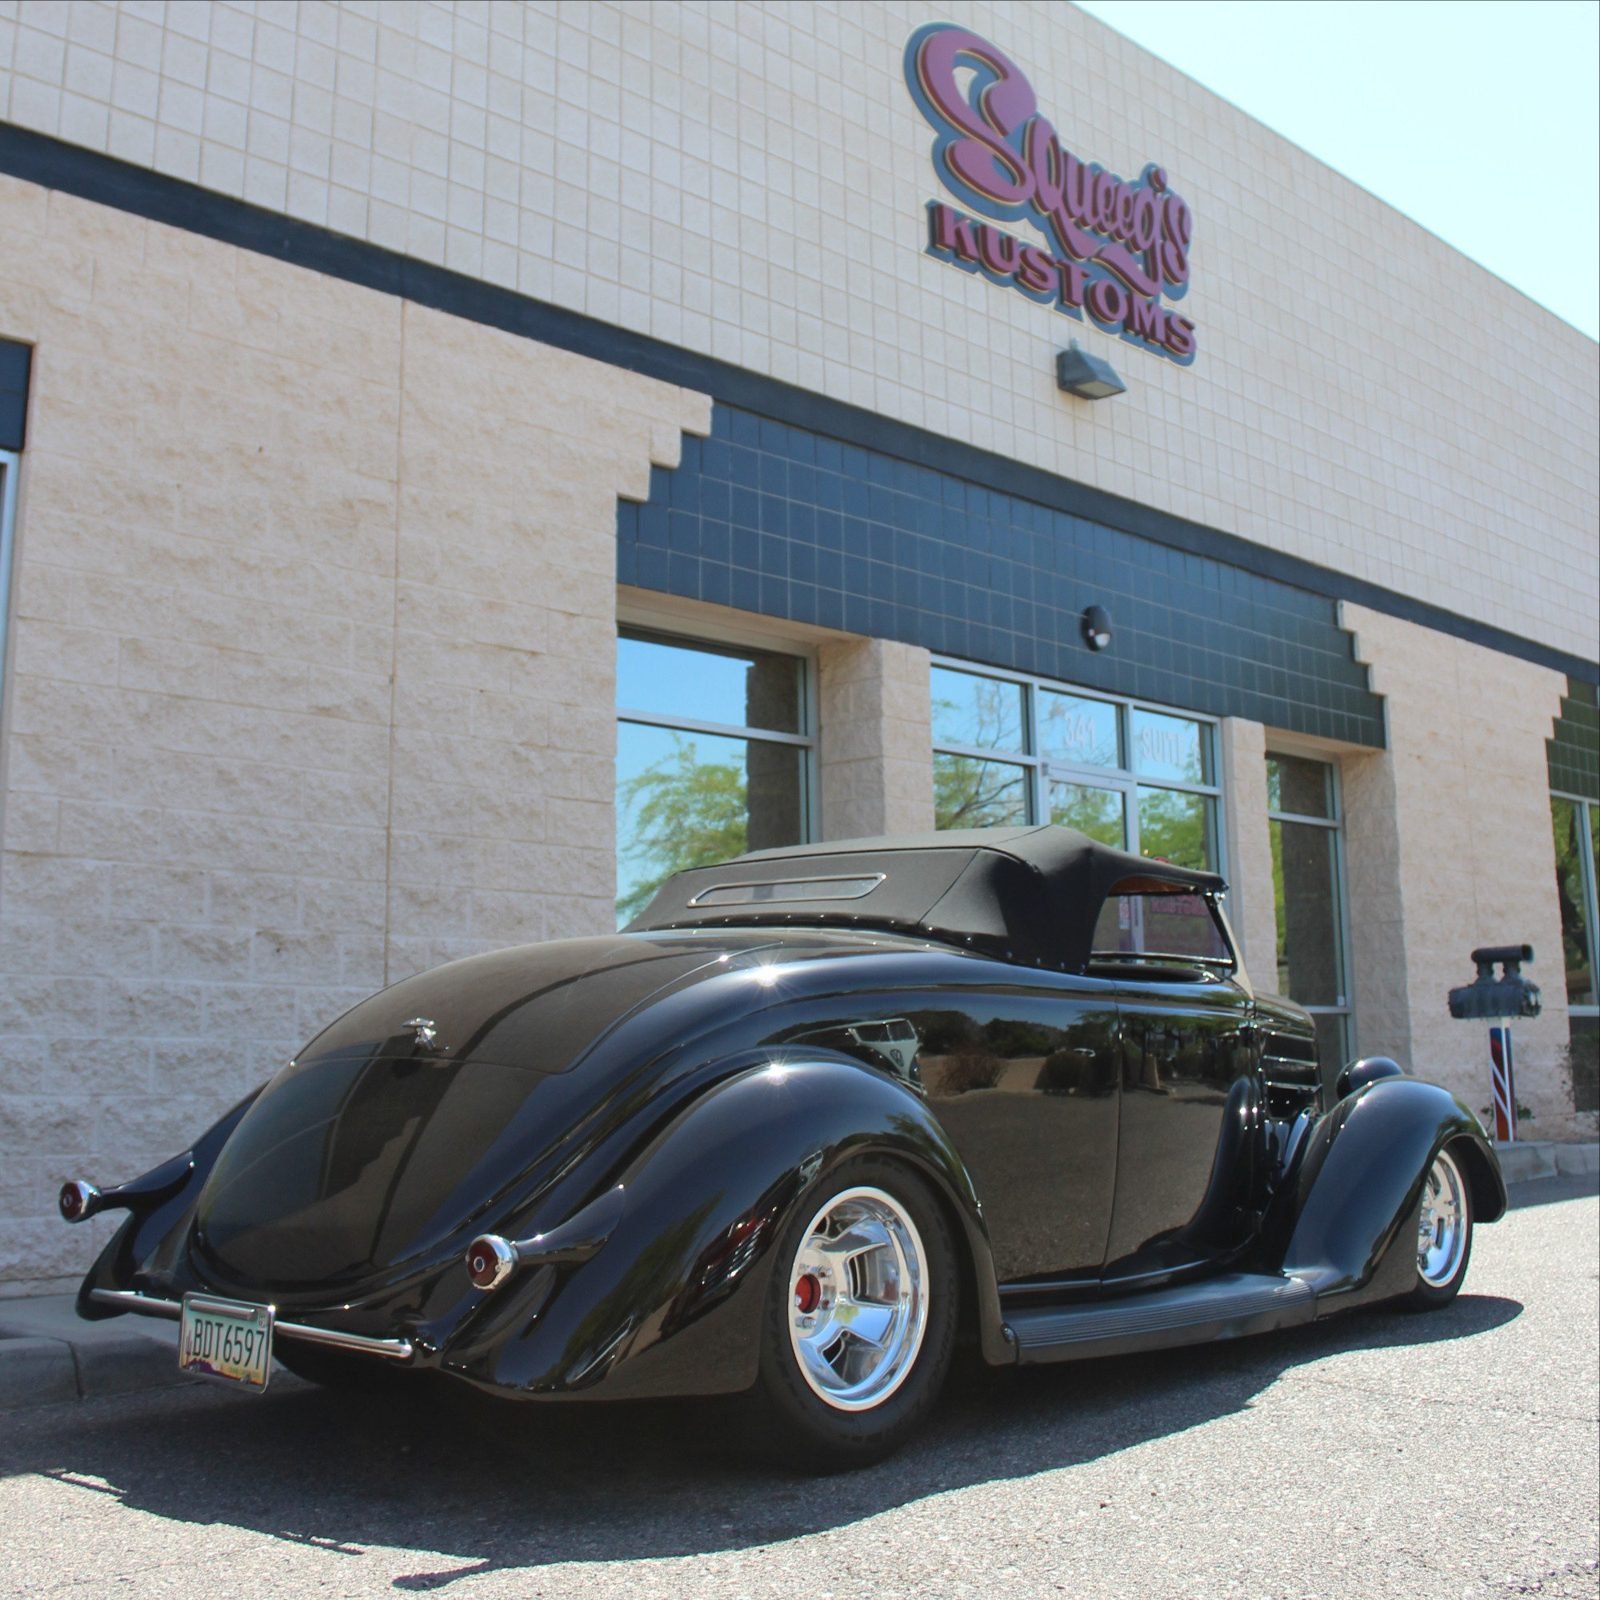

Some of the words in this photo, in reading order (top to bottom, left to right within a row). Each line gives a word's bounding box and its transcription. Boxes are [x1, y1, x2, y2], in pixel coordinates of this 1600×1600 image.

[929, 202, 1196, 358] KUSTOMS
[1064, 711, 1097, 752] 341
[192, 1318, 265, 1370] BDT6597
